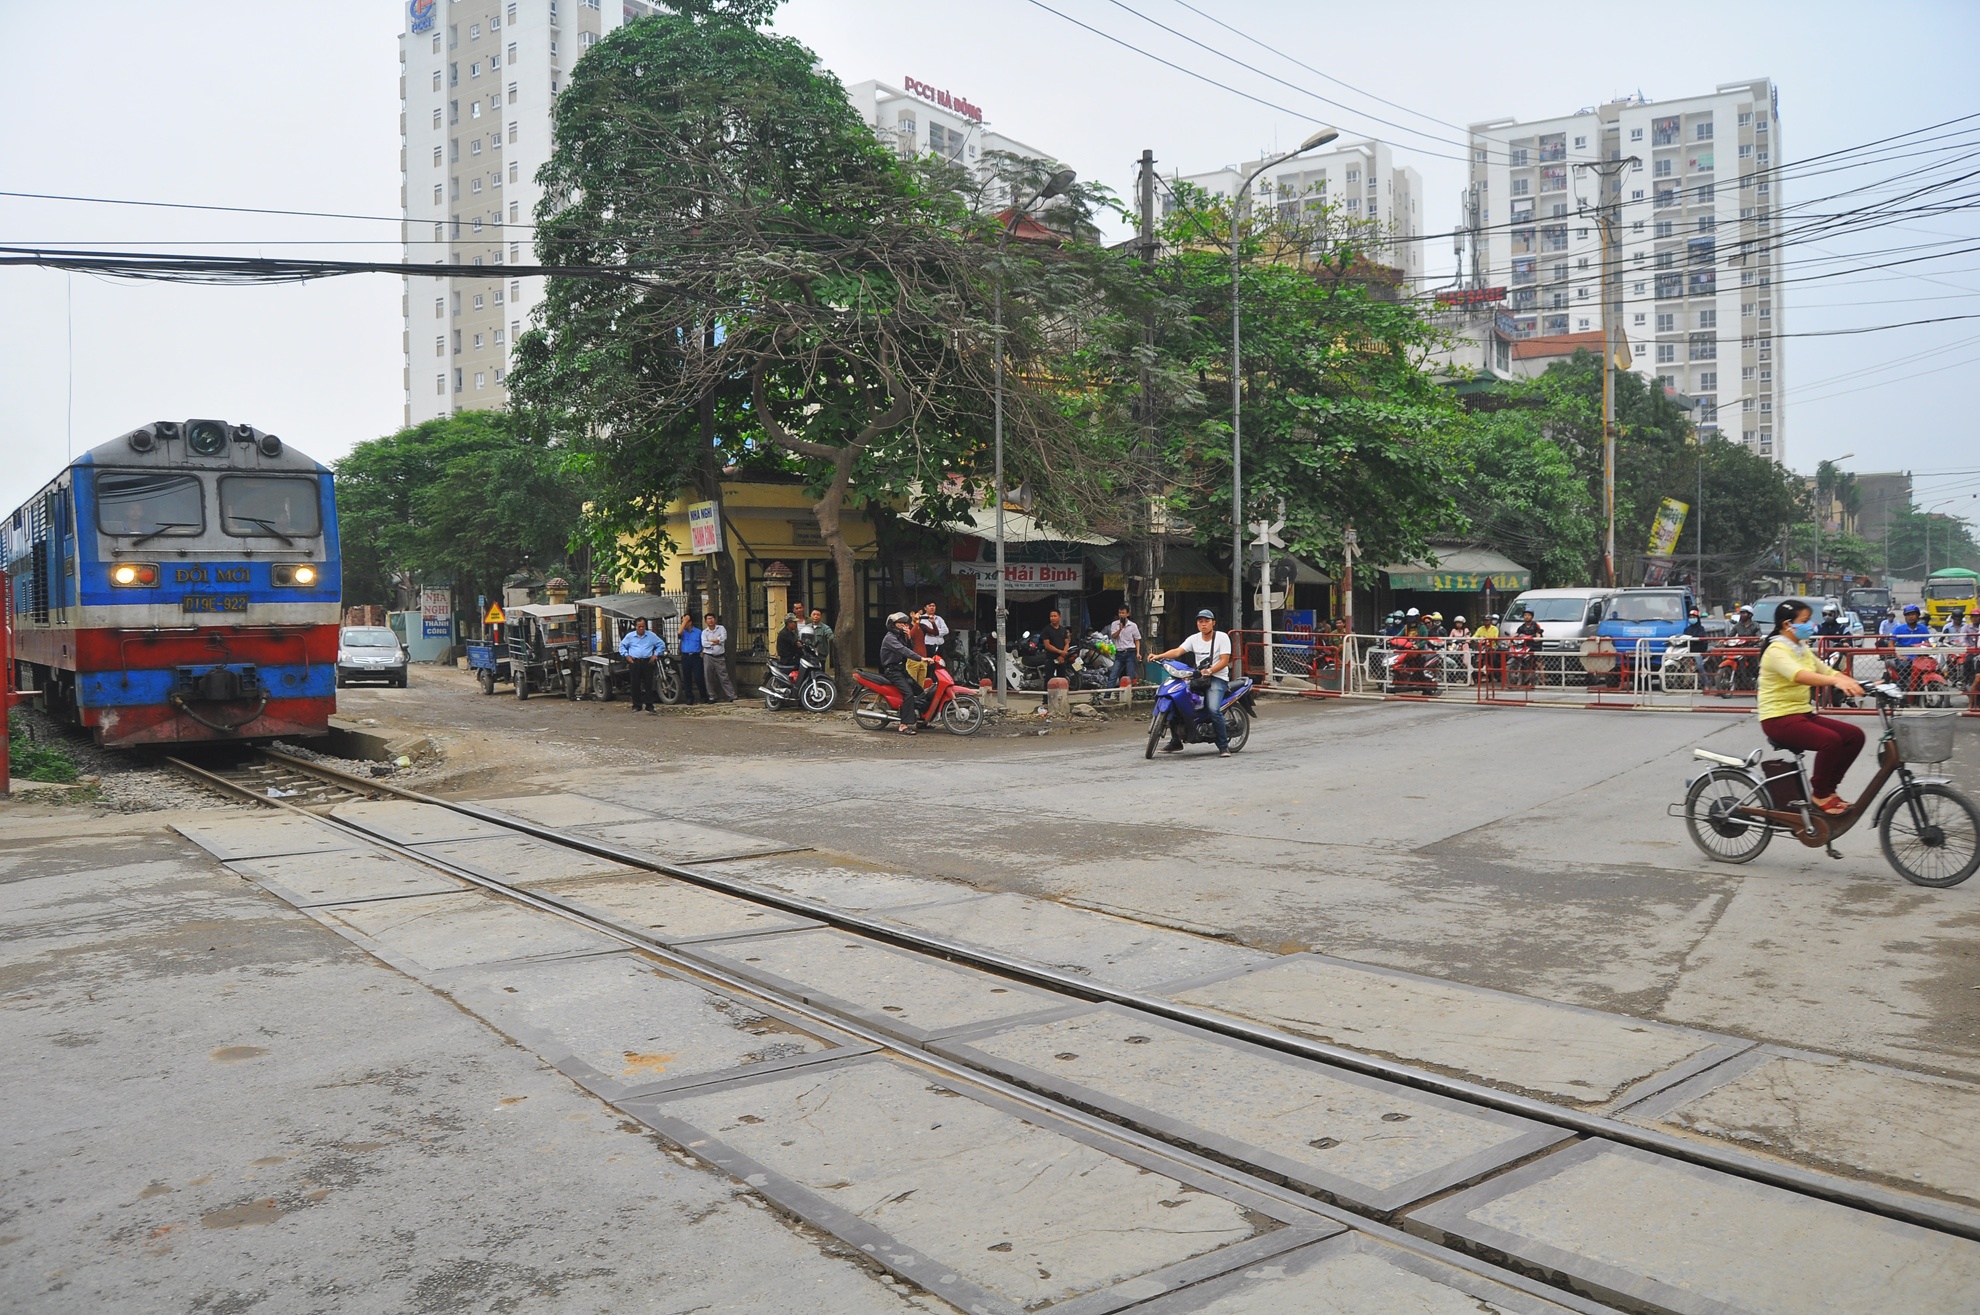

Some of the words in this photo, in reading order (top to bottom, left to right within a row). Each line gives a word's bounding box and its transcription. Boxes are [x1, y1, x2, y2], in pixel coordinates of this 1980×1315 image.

[905, 76, 934, 101] PCC1
[1005, 565, 1034, 580] Hải
[1040, 565, 1077, 581] Bình
[425, 590, 447, 602] NHÀ
[185, 597, 246, 611] D19E-922
[426, 627, 447, 635] CÔNG
